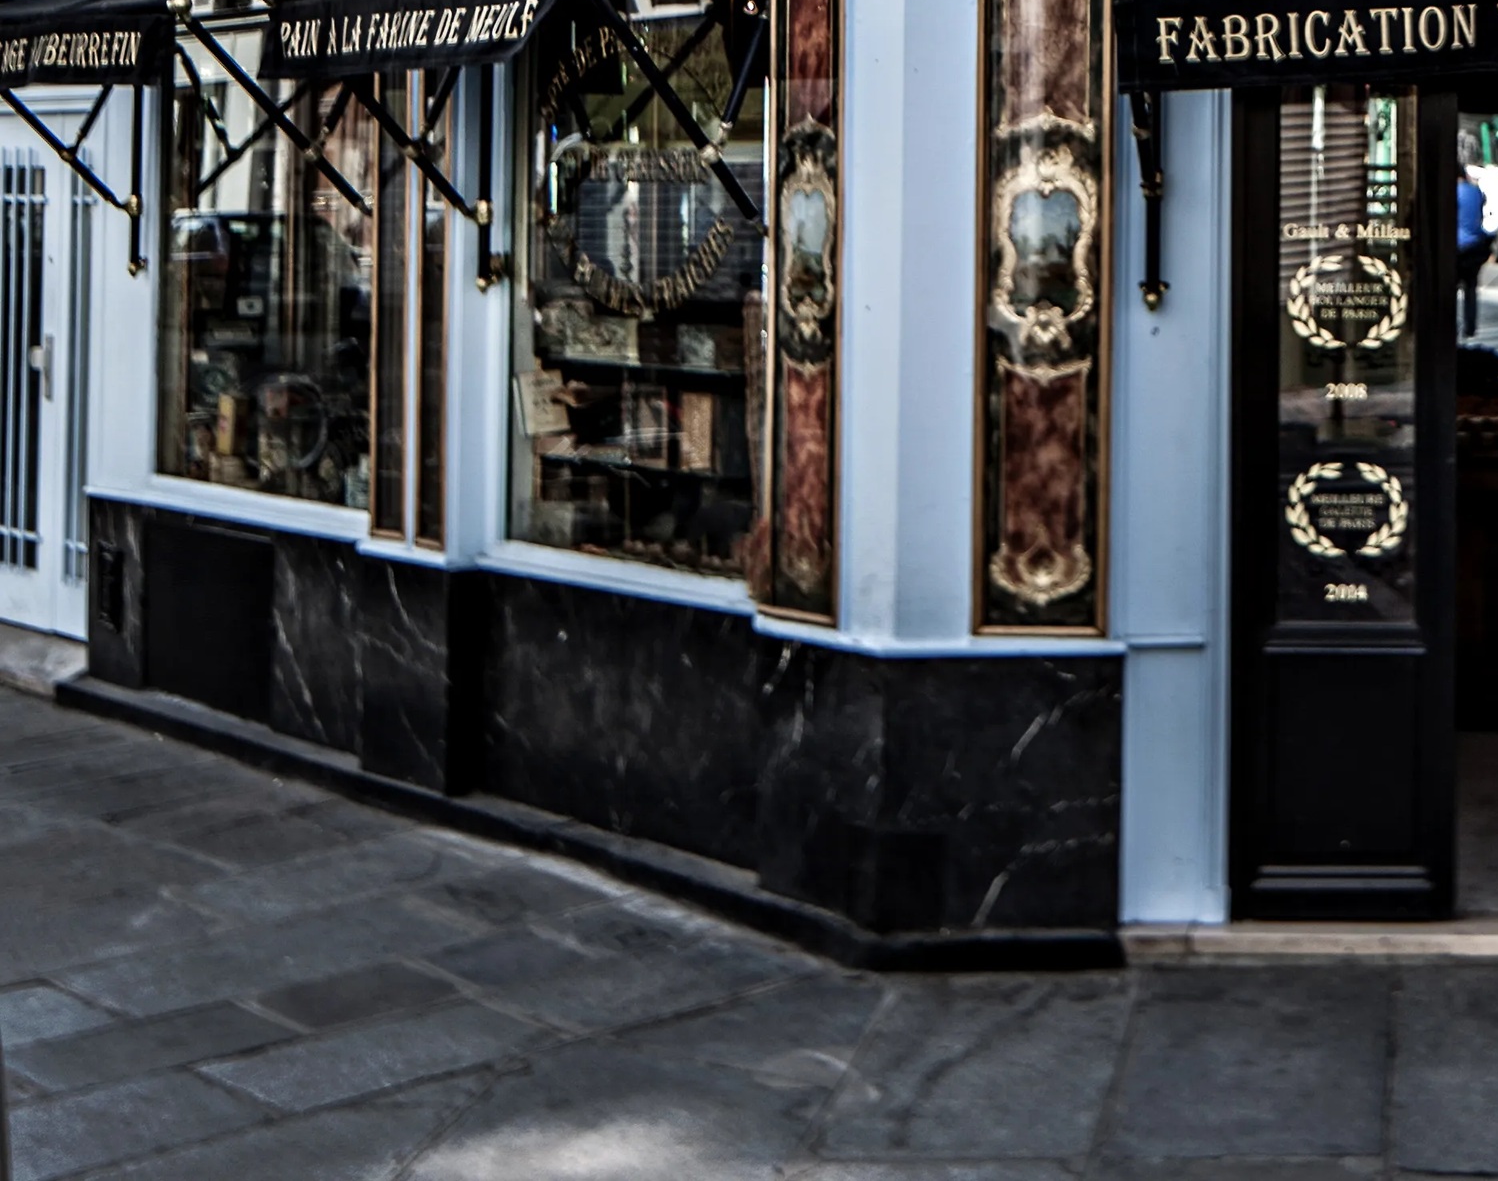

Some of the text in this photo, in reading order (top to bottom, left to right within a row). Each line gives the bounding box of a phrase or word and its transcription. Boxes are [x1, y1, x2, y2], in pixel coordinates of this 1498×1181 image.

[0, 36, 28, 76] AGE
[111, 30, 142, 67] FIN
[280, 18, 321, 59] PAIN
[341, 14, 362, 54] LA
[366, 8, 436, 51] FARINE
[433, 6, 467, 47] DE
[1156, 3, 1479, 65] FABRICATION
[1334, 224, 1351, 239] &
